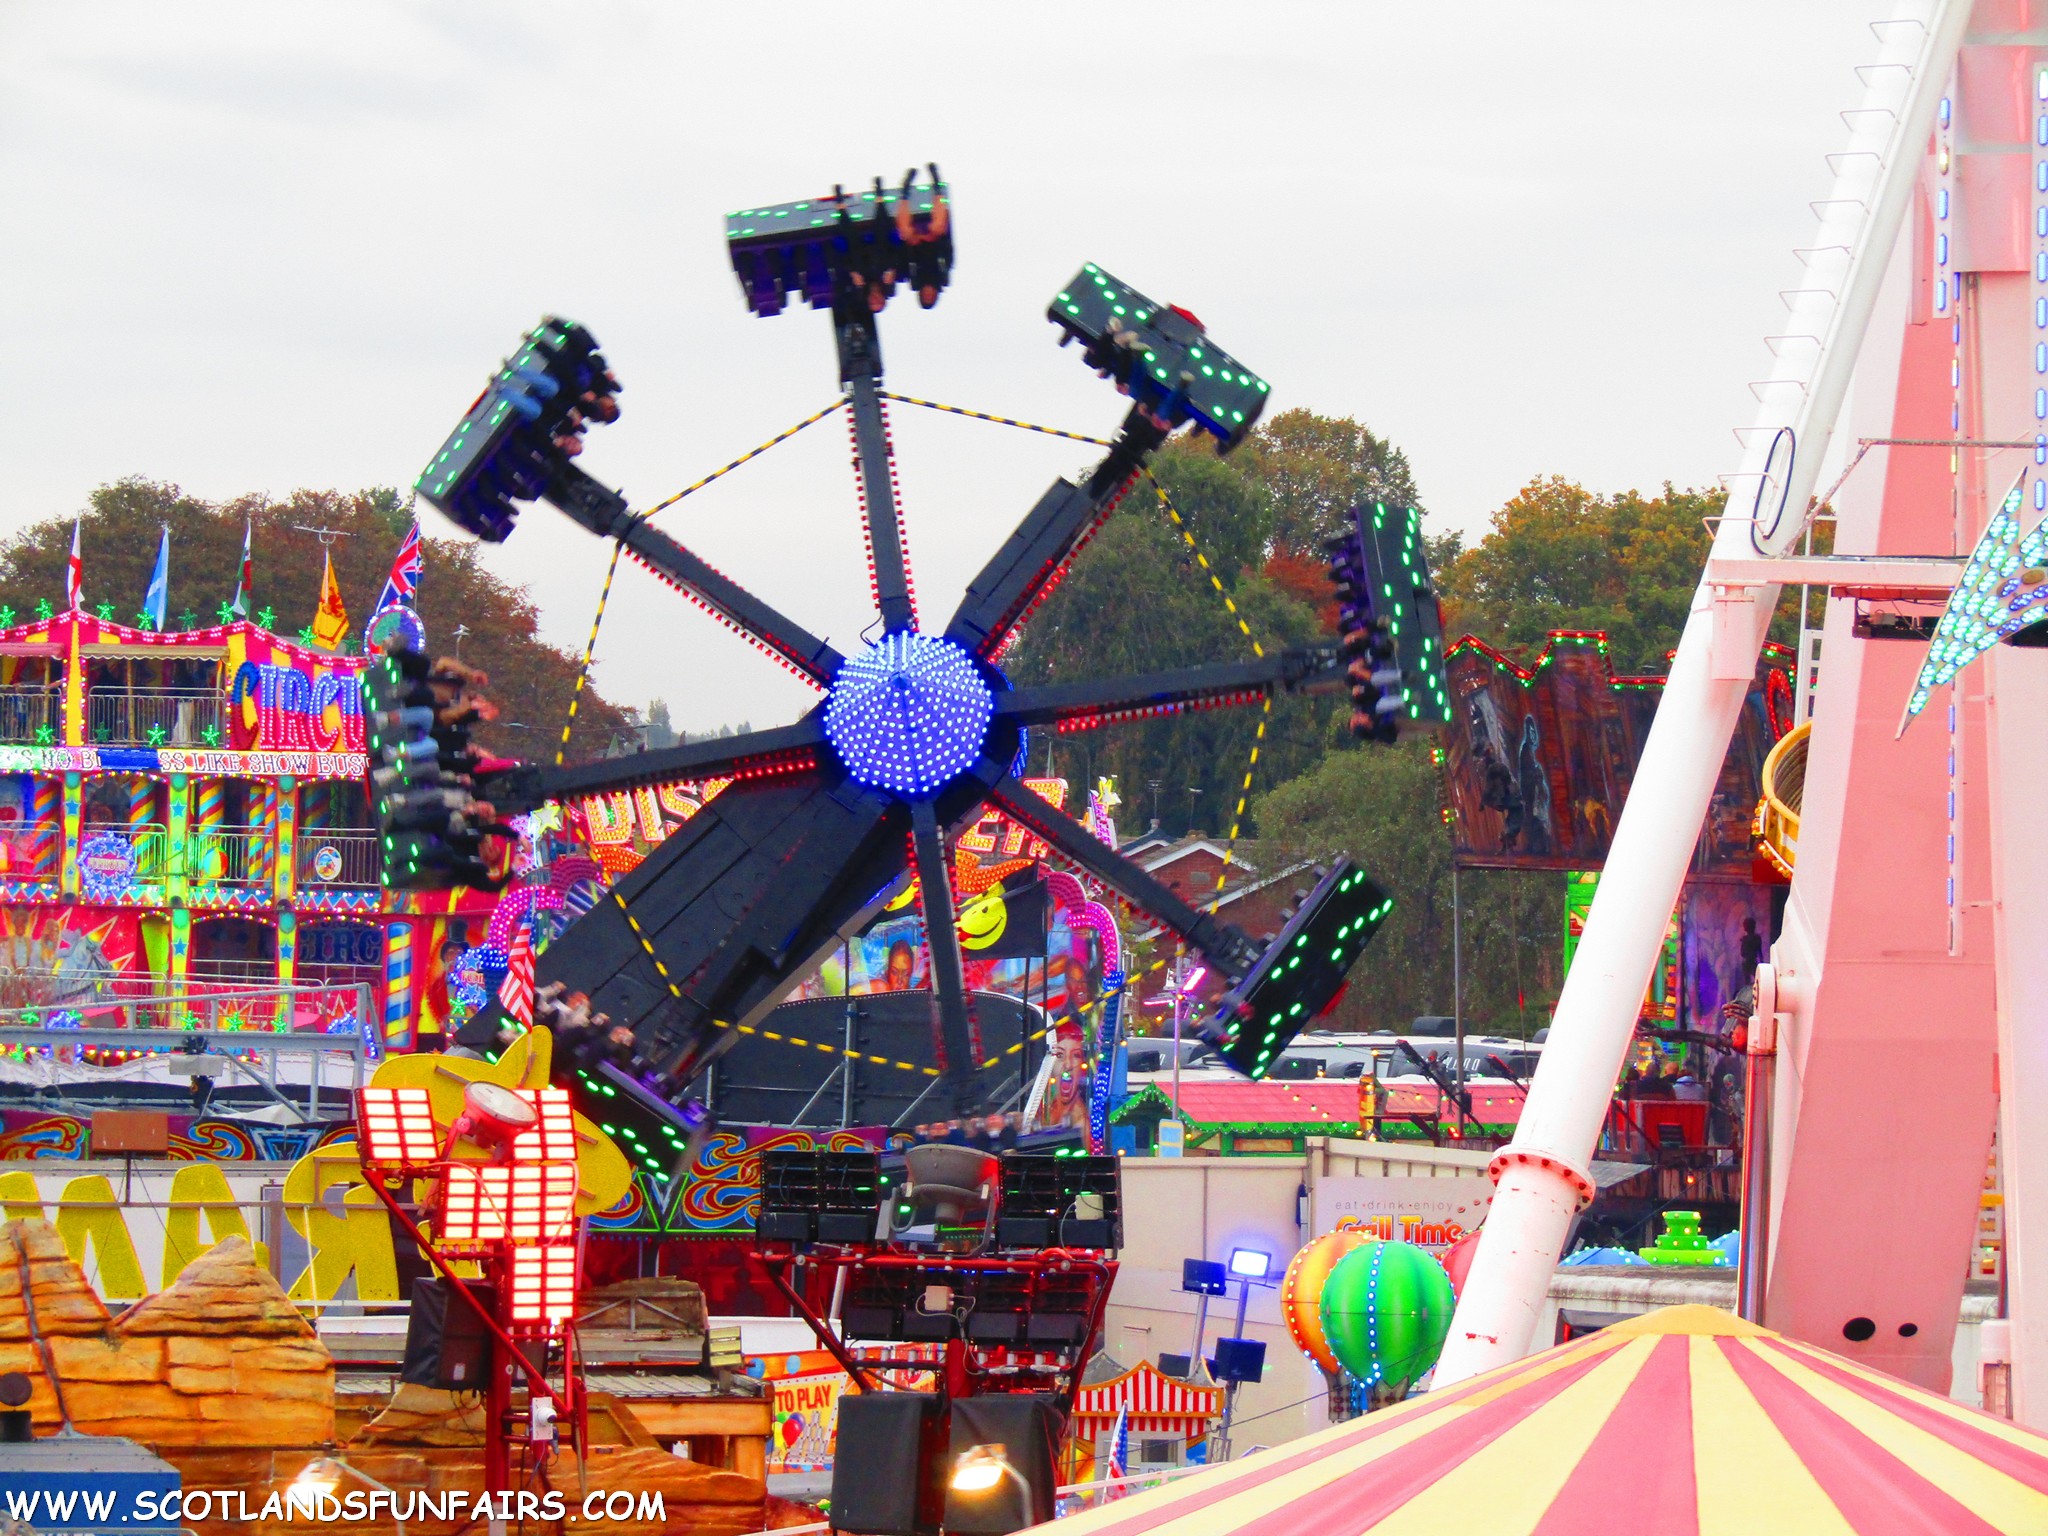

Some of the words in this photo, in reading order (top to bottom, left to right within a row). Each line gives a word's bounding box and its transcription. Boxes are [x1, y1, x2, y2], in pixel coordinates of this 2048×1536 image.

[39, 748, 69, 769] NO
[192, 751, 244, 774] LIKE
[248, 753, 310, 775] SHOW
[1336, 1214, 1393, 1241] Grill
[775, 1390, 793, 1413] TO
[797, 1384, 831, 1411] PLAY
